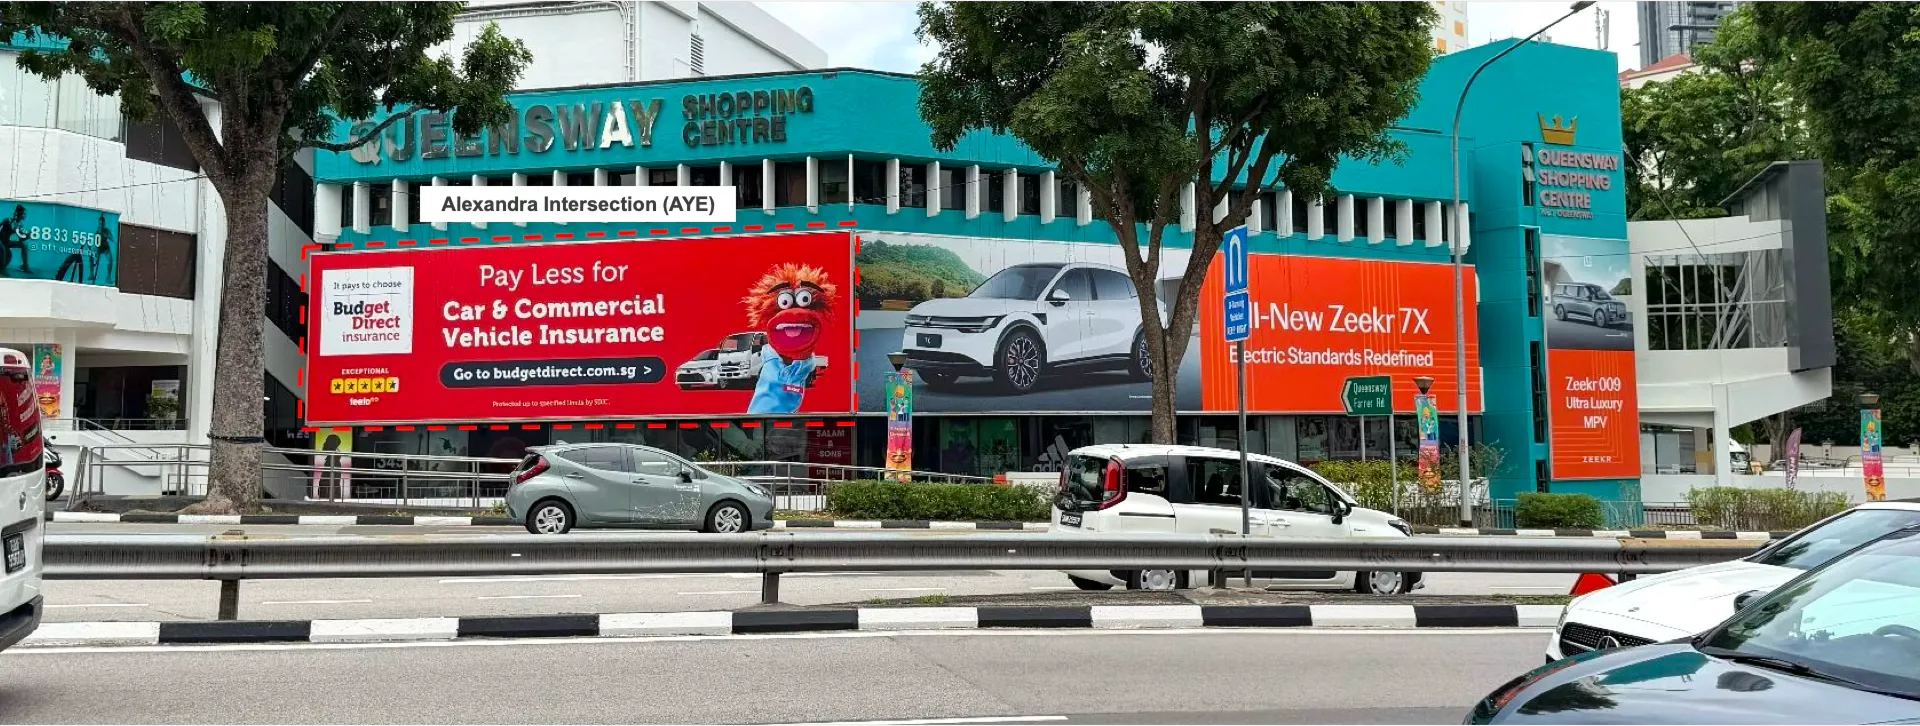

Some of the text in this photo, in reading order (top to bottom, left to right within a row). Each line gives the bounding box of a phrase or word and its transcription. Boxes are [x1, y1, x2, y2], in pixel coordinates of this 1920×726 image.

[682, 86, 814, 120] SHOPPING
[682, 116, 788, 147] CENTRE
[1538, 149, 1618, 171] QUEENSWAY
[1539, 169, 1611, 190] SHOPPING
[1540, 189, 1591, 209] CENTRE
[72, 231, 101, 248] 5550
[479, 260, 629, 291] Pay Less for
[333, 280, 402, 291] It pays to choose
[333, 301, 389, 318] Budget
[443, 294, 665, 321] Car & Commercial
[351, 317, 401, 330] Direct
[1328, 304, 1395, 333] Zeekr
[1399, 307, 1430, 335] 7X
[342, 331, 400, 343] insurance
[442, 324, 665, 348] Vehicle Insurance
[1287, 345, 1362, 366] Standards
[1364, 350, 1434, 367] Redefined
[341, 368, 390, 376] EXCEPTIONAL
[453, 364, 637, 382] Go to budgetdirect.com.sg
[1353, 382, 1388, 395] Queensway
[1565, 377, 1621, 392] Zeekr 009
[1353, 398, 1373, 408] Farrer
[1566, 397, 1623, 412] Ultra Luxury
[1584, 416, 1607, 429] MPV
